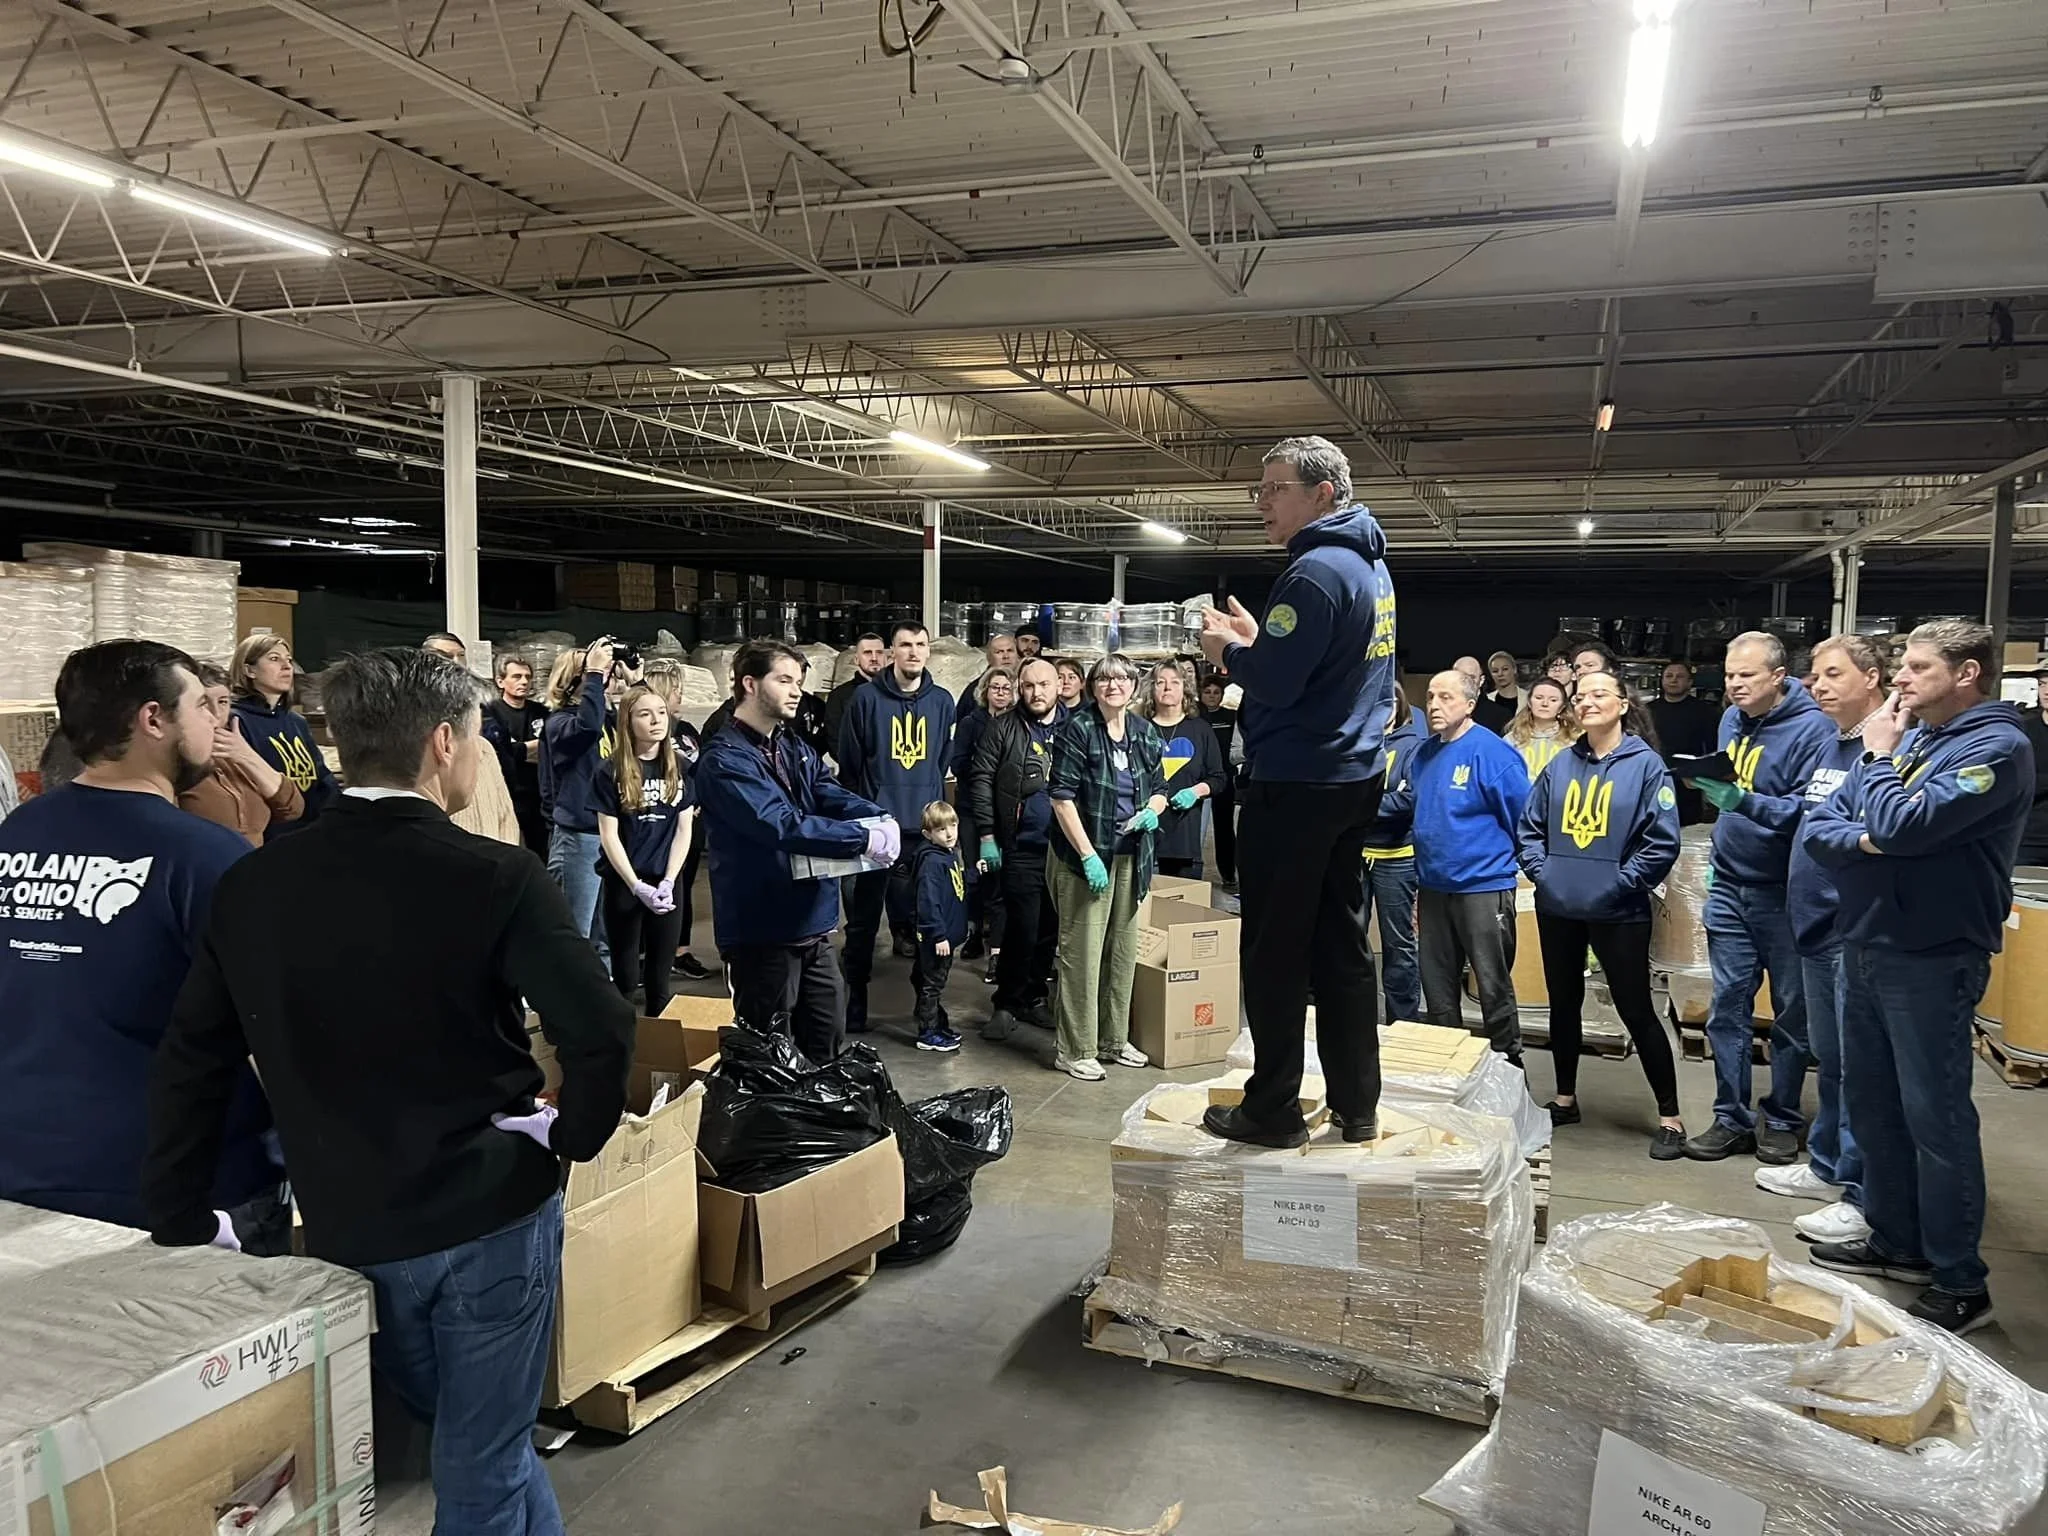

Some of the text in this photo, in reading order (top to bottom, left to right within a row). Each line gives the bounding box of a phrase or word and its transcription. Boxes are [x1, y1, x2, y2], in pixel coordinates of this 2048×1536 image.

[0, 852, 86, 881] DOLAN
[13, 881, 75, 907] OHIO
[14, 906, 55, 921] SENATE
[1170, 972, 1197, 981] LARGE
[1273, 1200, 1296, 1211] NIKE
[1299, 1204, 1312, 1212] AR
[1278, 1216, 1306, 1227] ARCH
[239, 1326, 288, 1371] HWI
[1638, 1485, 1711, 1530] NIKE AR 60
[1642, 1509, 1681, 1536] ARCH
